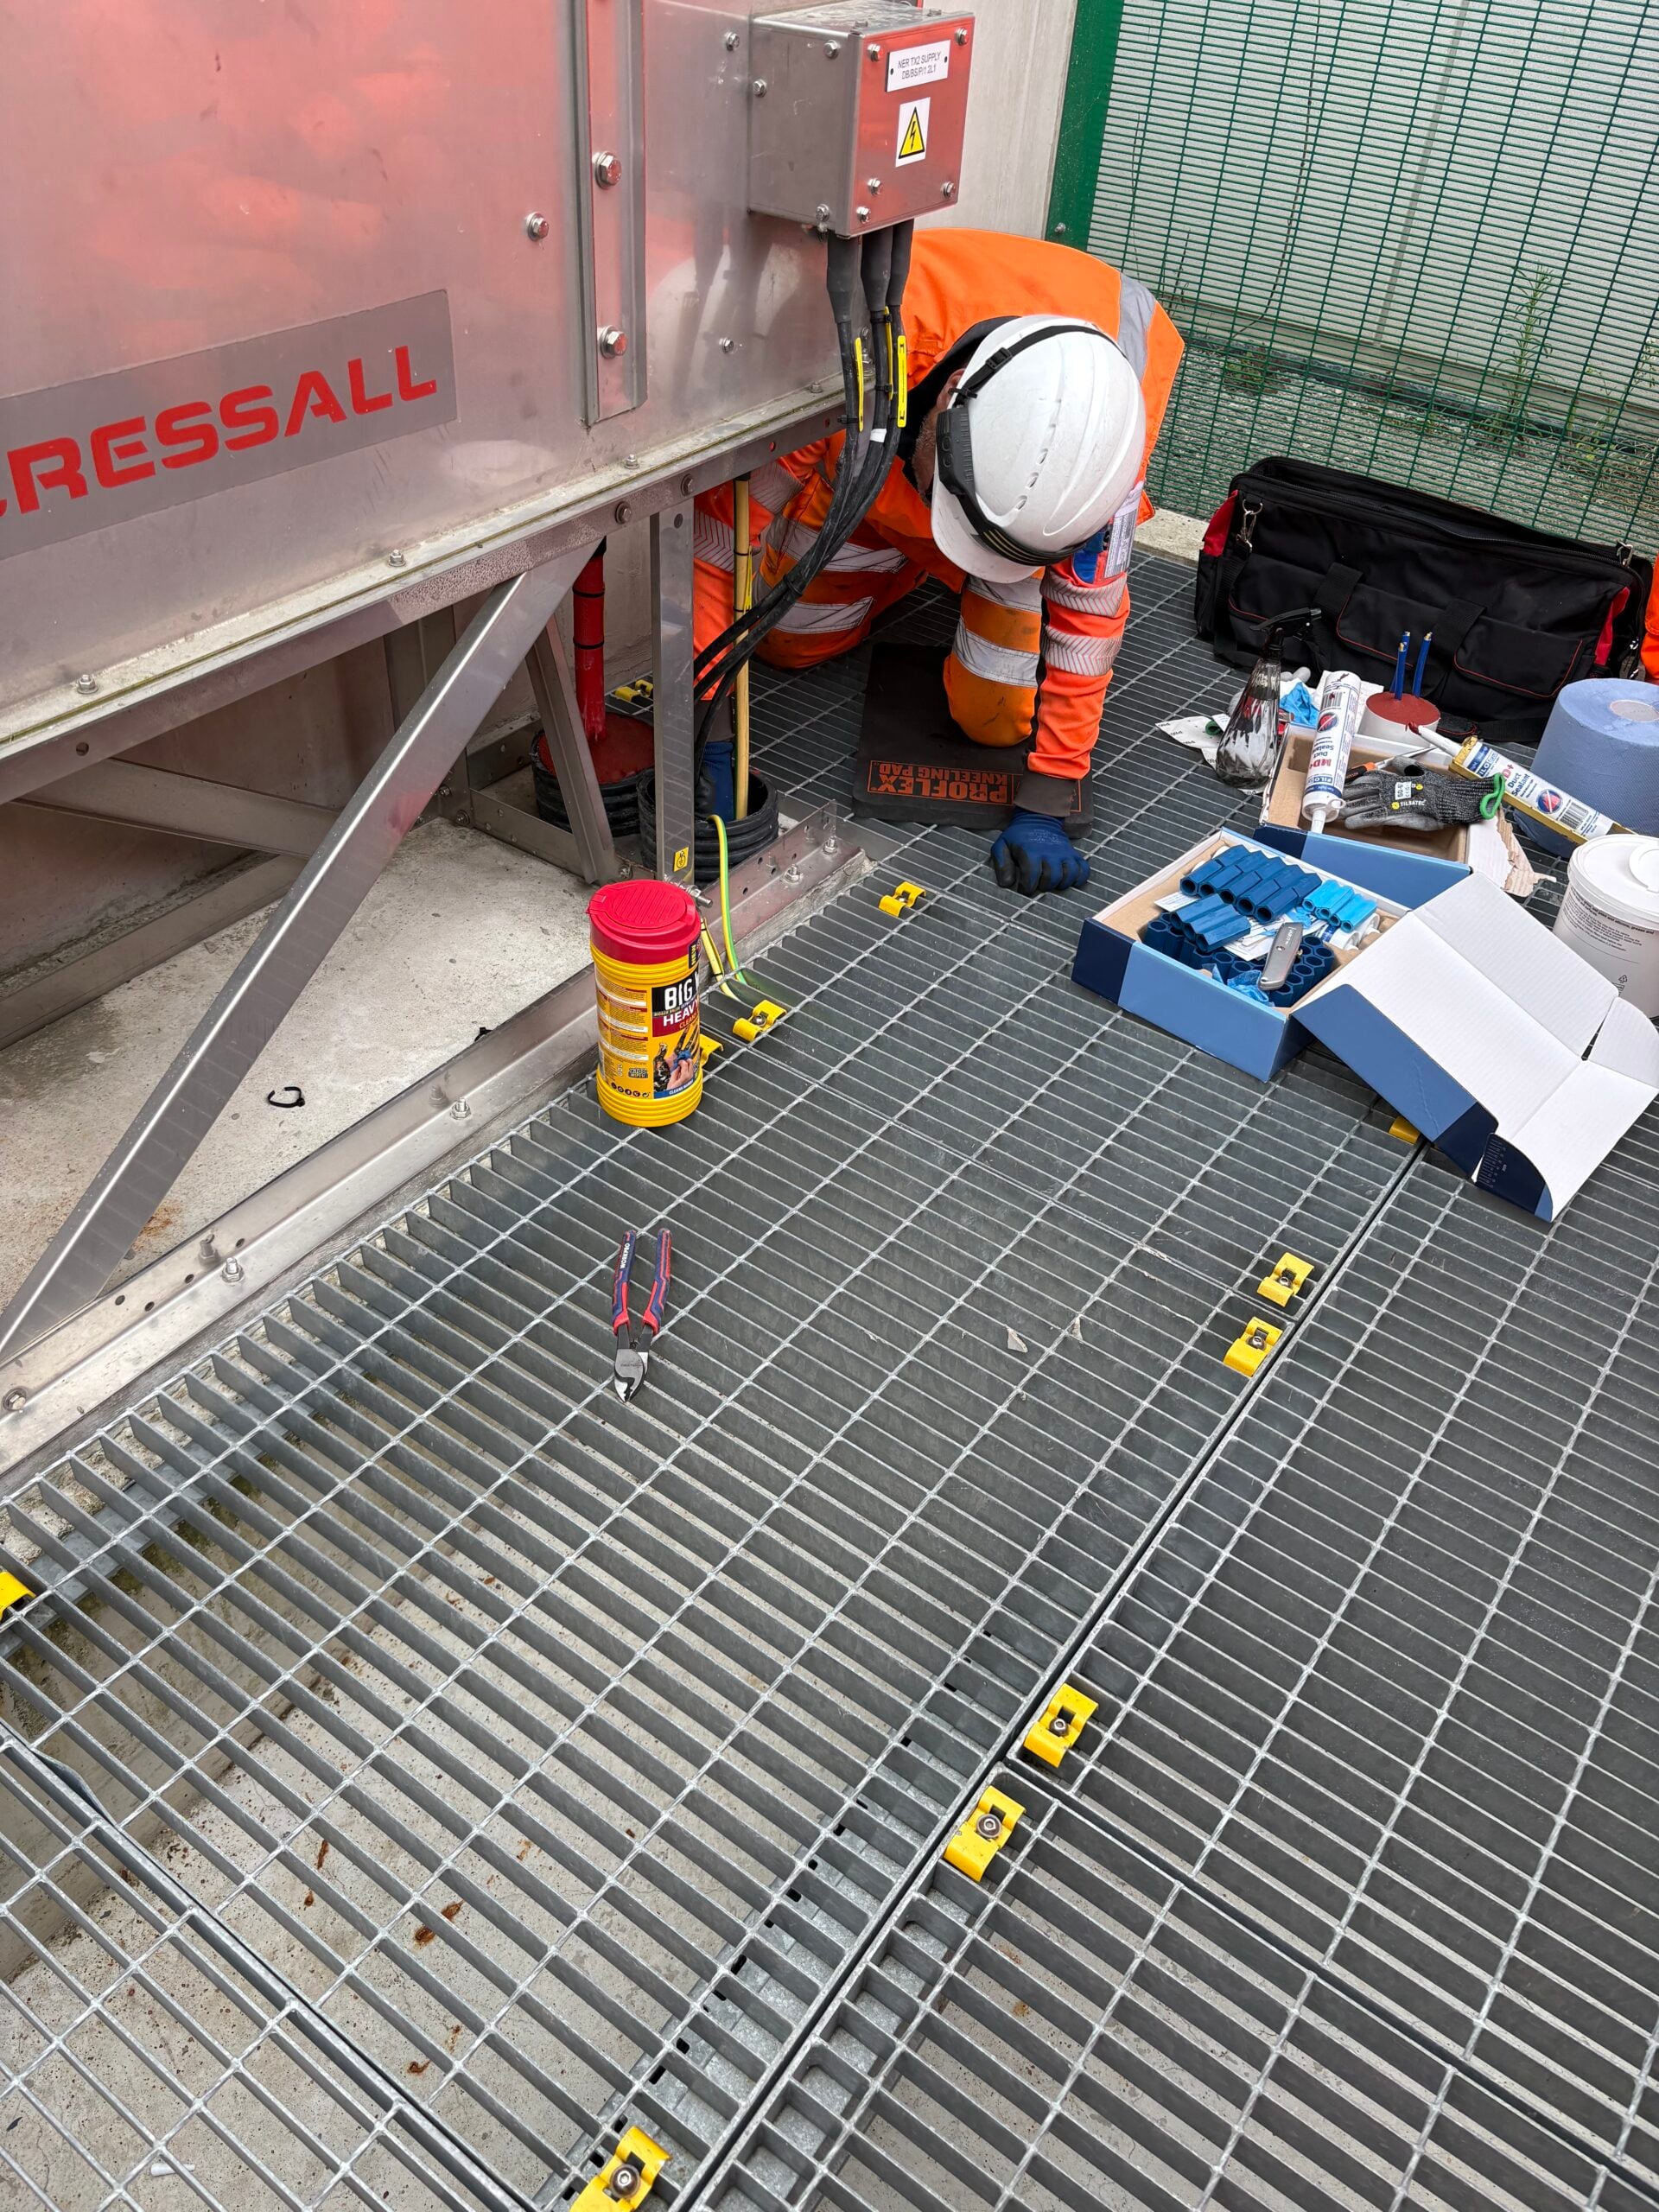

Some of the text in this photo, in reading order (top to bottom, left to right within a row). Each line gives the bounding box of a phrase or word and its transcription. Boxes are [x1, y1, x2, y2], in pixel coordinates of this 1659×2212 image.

[920, 51, 942, 65] SUPPLY
[0, 345, 437, 518] RESSALL
[879, 763, 1007, 786] KNEELING PAD
[1507, 772, 1522, 788] Duct
[1512, 773, 1530, 797] Sealant
[876, 773, 1007, 804] PROFLEX
[664, 978, 693, 1011] BIG
[620, 1243, 631, 1269] WORKPRO
